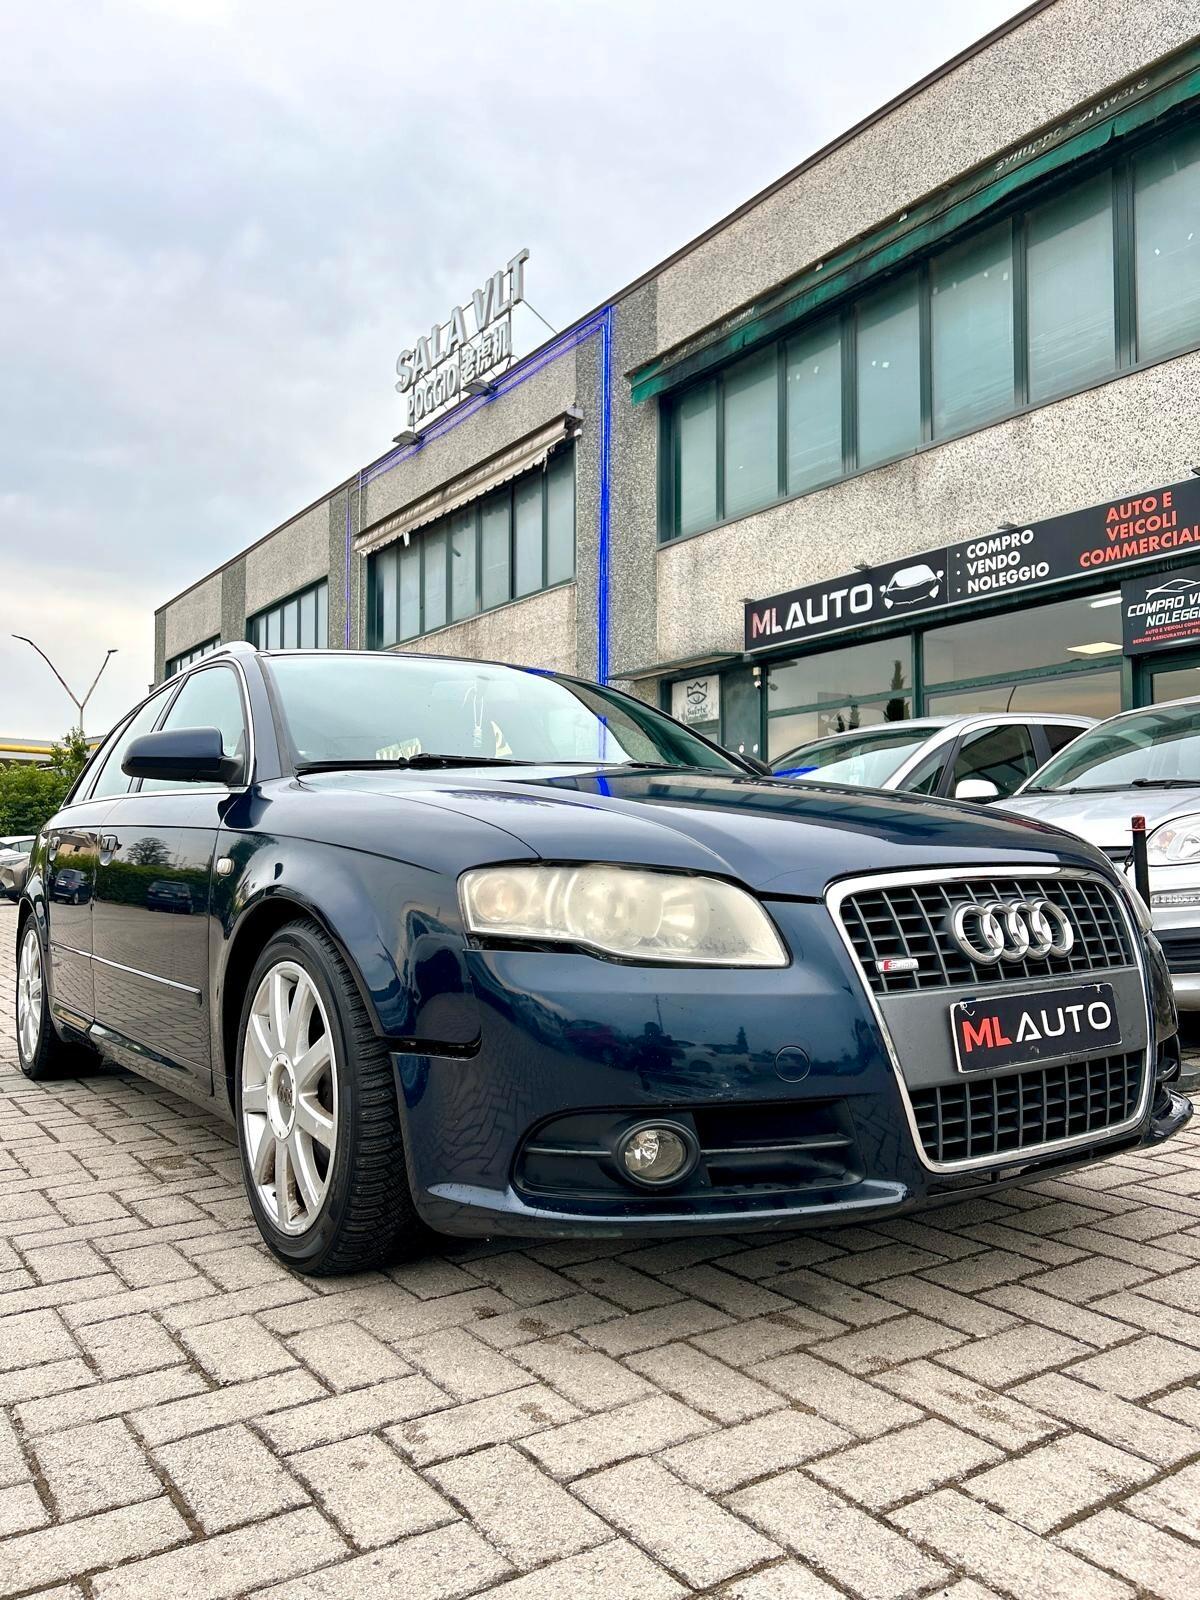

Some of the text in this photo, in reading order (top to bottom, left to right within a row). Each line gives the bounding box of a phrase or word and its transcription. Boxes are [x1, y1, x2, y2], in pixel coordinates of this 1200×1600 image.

[395, 247, 530, 394] SALA VLT
[407, 362, 461, 426] POGGIO
[1106, 491, 1172, 524] AUTO E
[1106, 510, 1177, 542] VEICOLI
[966, 529, 1034, 559] COMPRO
[966, 550, 1021, 576] VENDO
[967, 561, 1050, 594] NOLEGGIO
[752, 583, 873, 639] ML AUTO
[1127, 595, 1185, 618] COMPRO
[1164, 623, 1183, 631] VEICOLI
[961, 1001, 1112, 1053] ML AUTO
